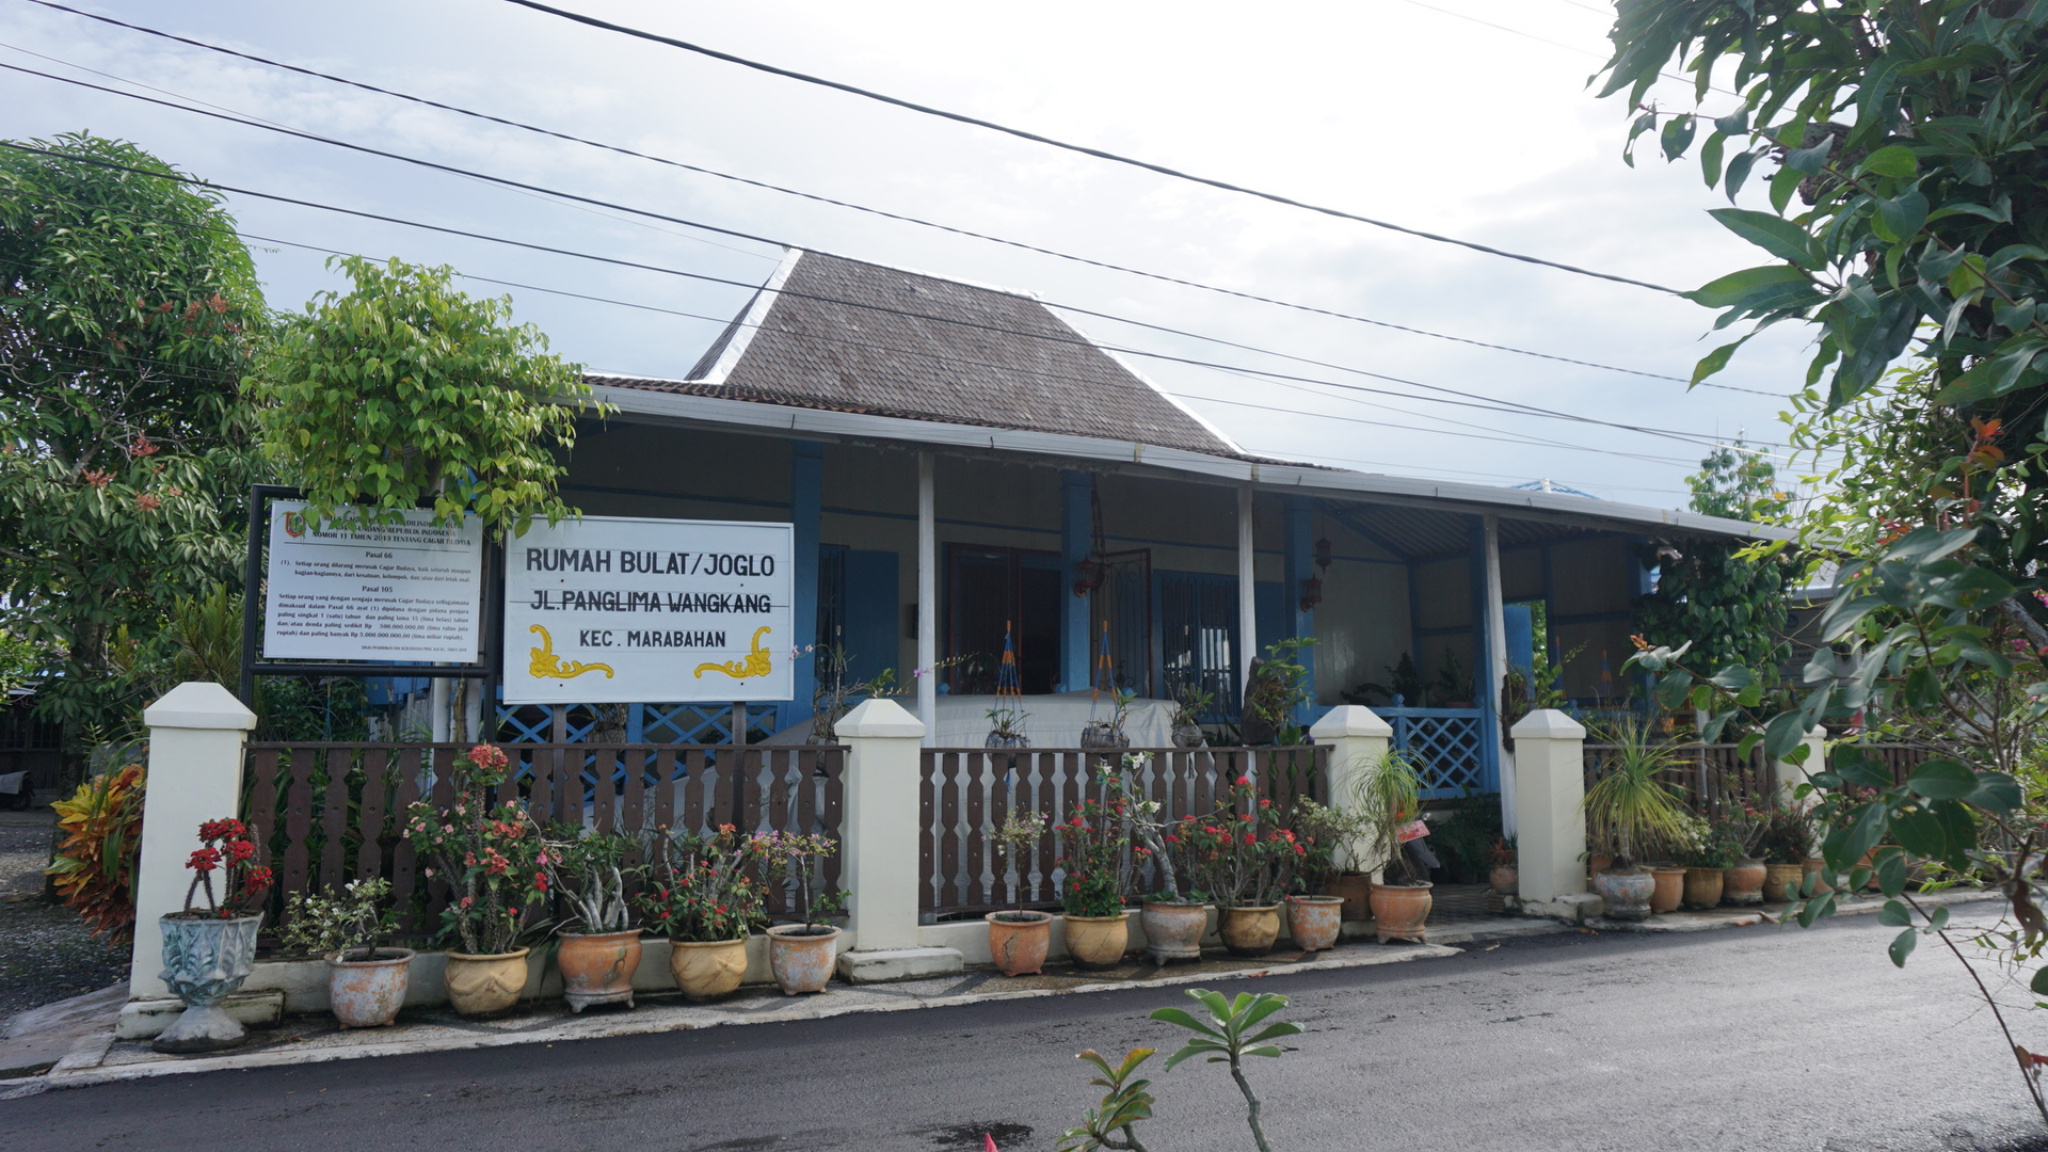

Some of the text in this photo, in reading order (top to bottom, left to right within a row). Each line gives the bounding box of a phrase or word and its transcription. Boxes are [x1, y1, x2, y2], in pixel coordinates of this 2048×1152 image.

[393, 535, 421, 543] TENTANG
[423, 537, 445, 545] CAGAR
[365, 551, 383, 559] Pasal
[526, 547, 775, 577] RUMAH BULAT/JOGLO
[331, 562, 353, 570] dilarang
[667, 592, 771, 614] WANGKANG
[627, 630, 726, 648] MARABAHAN
